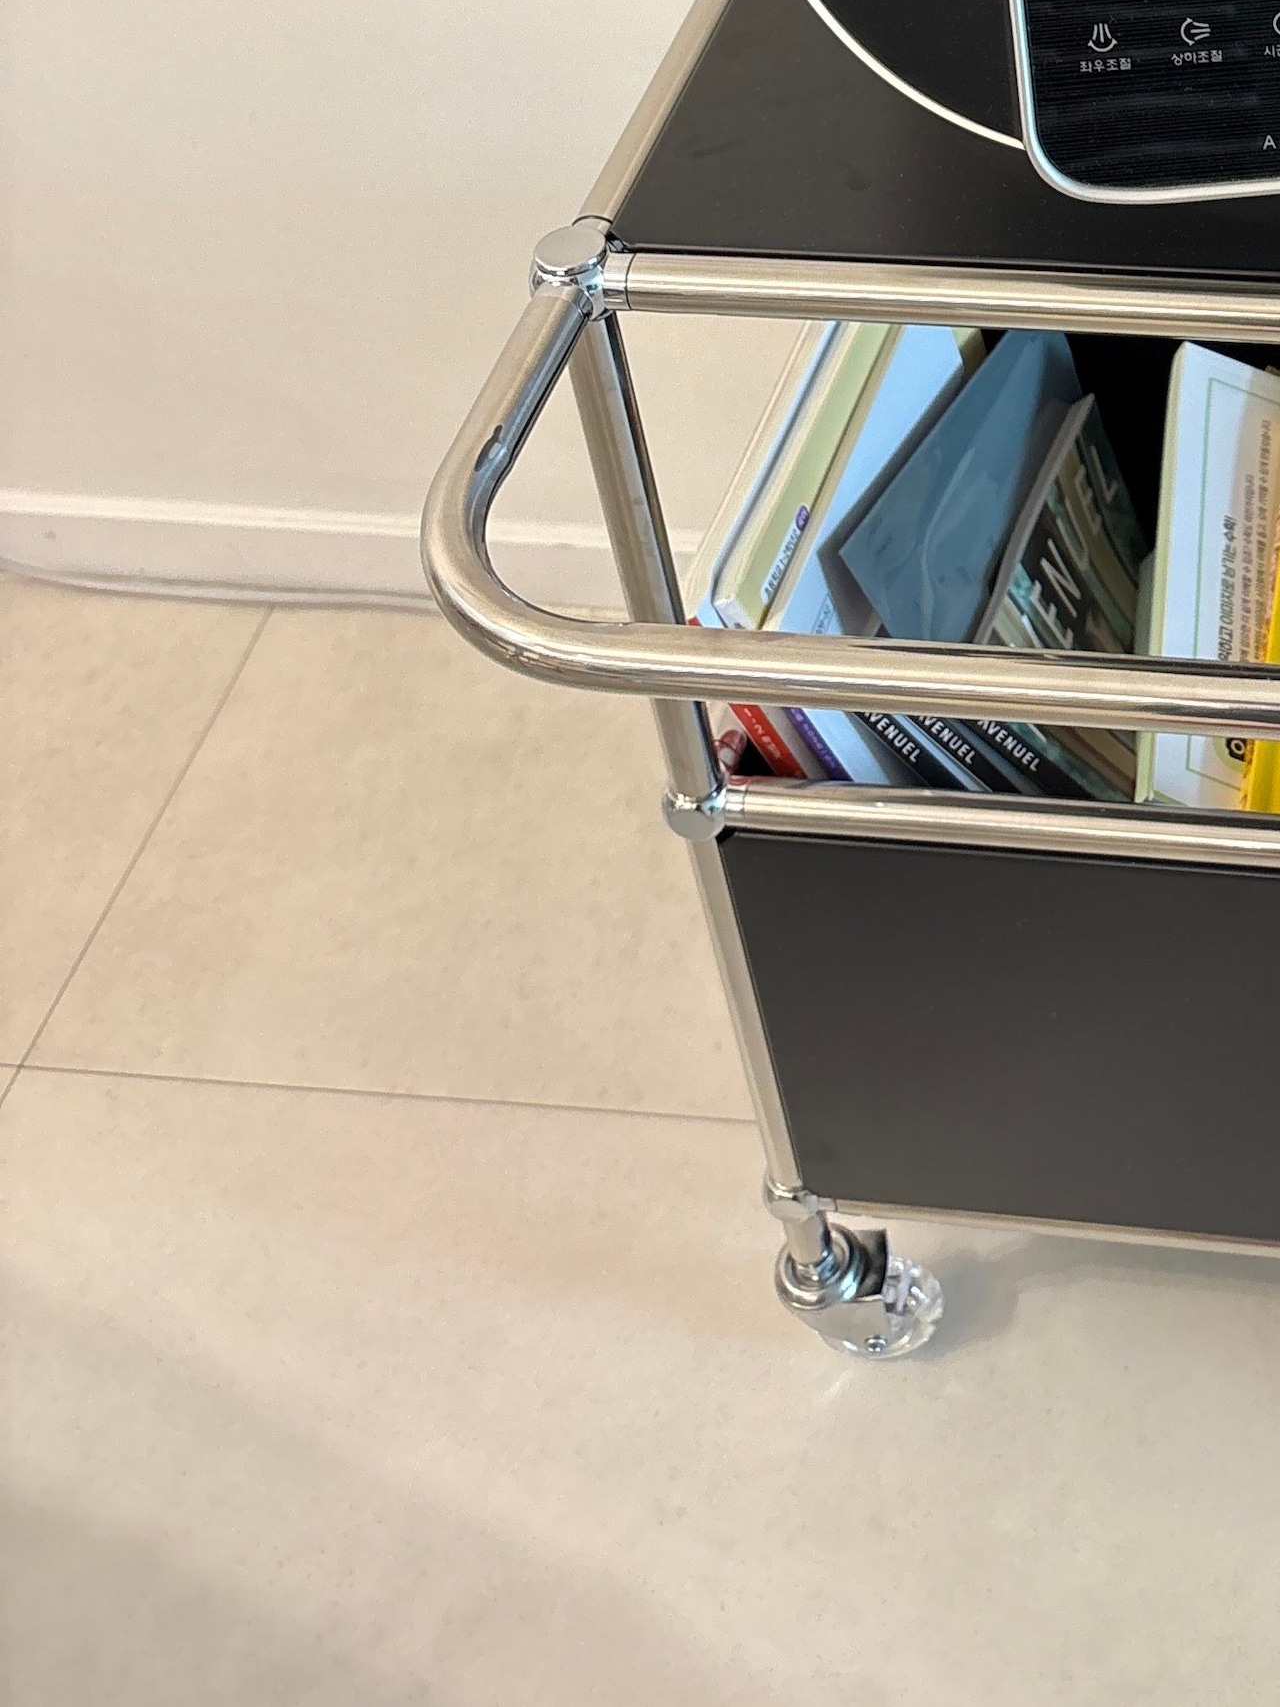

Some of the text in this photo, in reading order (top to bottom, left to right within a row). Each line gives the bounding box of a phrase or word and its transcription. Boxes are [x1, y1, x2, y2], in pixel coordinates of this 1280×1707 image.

[1079, 57, 1132, 74] 좌우조절
[1171, 49, 1223, 67] 상하조절
[1262, 134, 1277, 150] A
